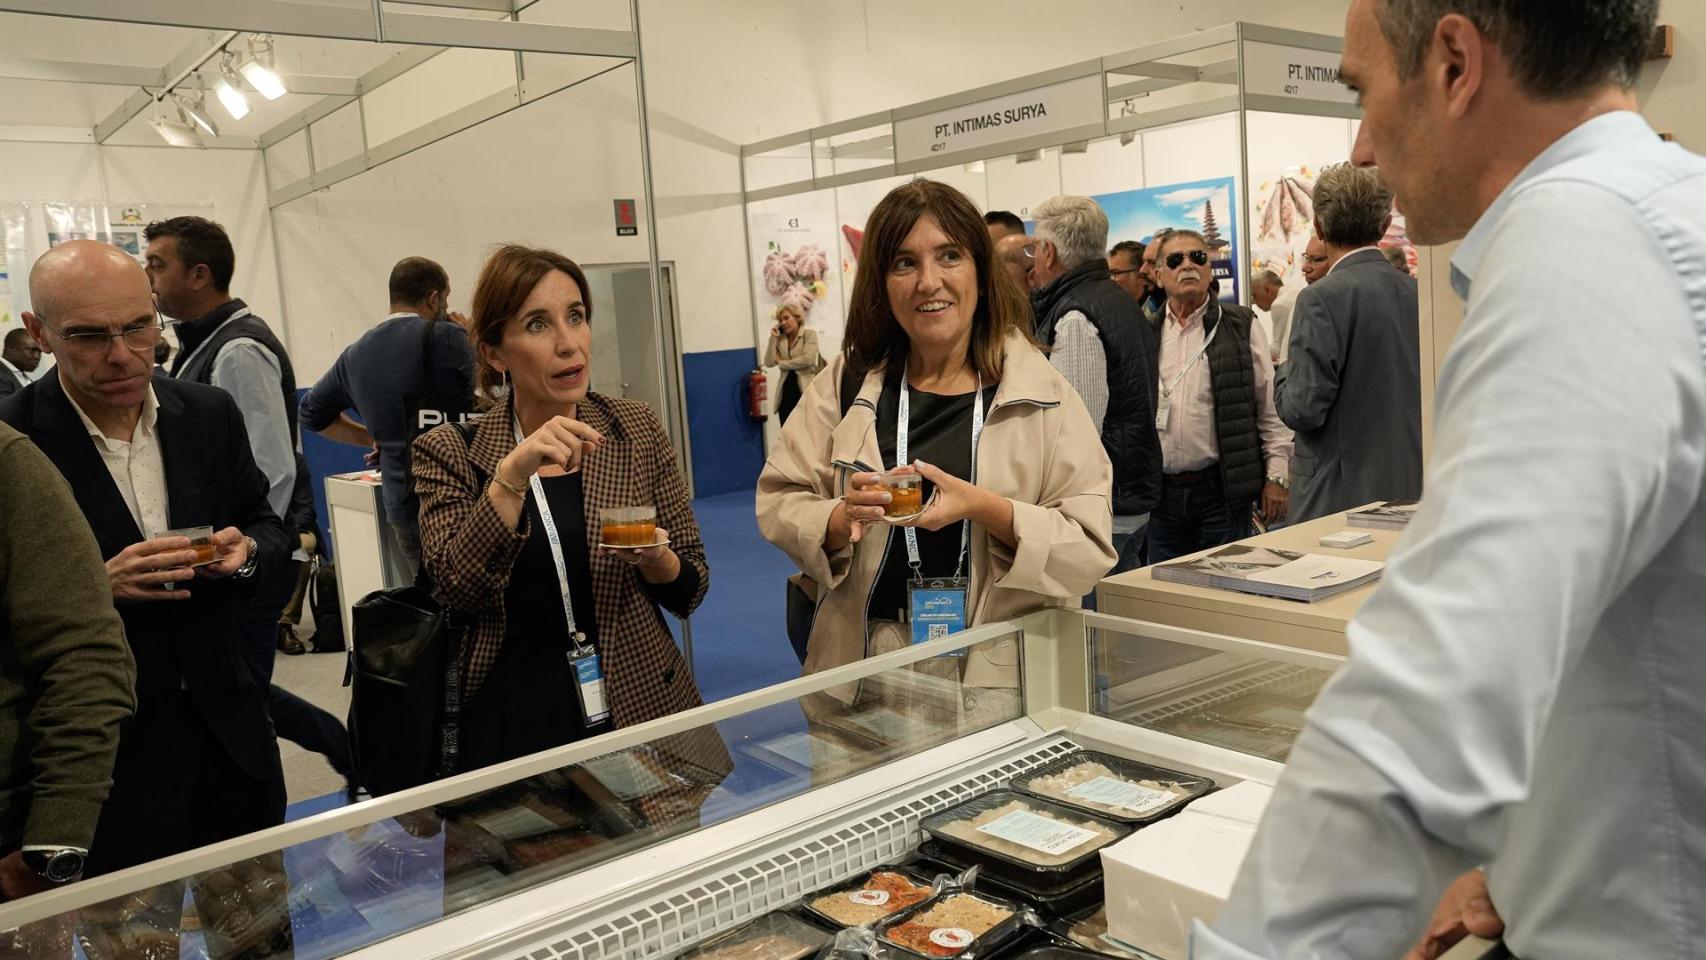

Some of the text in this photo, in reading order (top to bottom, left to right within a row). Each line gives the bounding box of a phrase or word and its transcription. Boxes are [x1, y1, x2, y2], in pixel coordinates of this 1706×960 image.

[1288, 64, 1303, 80] PT.
[935, 102, 1047, 139] PT. INTIMAS SURYA
[931, 142, 946, 152] 4D17
